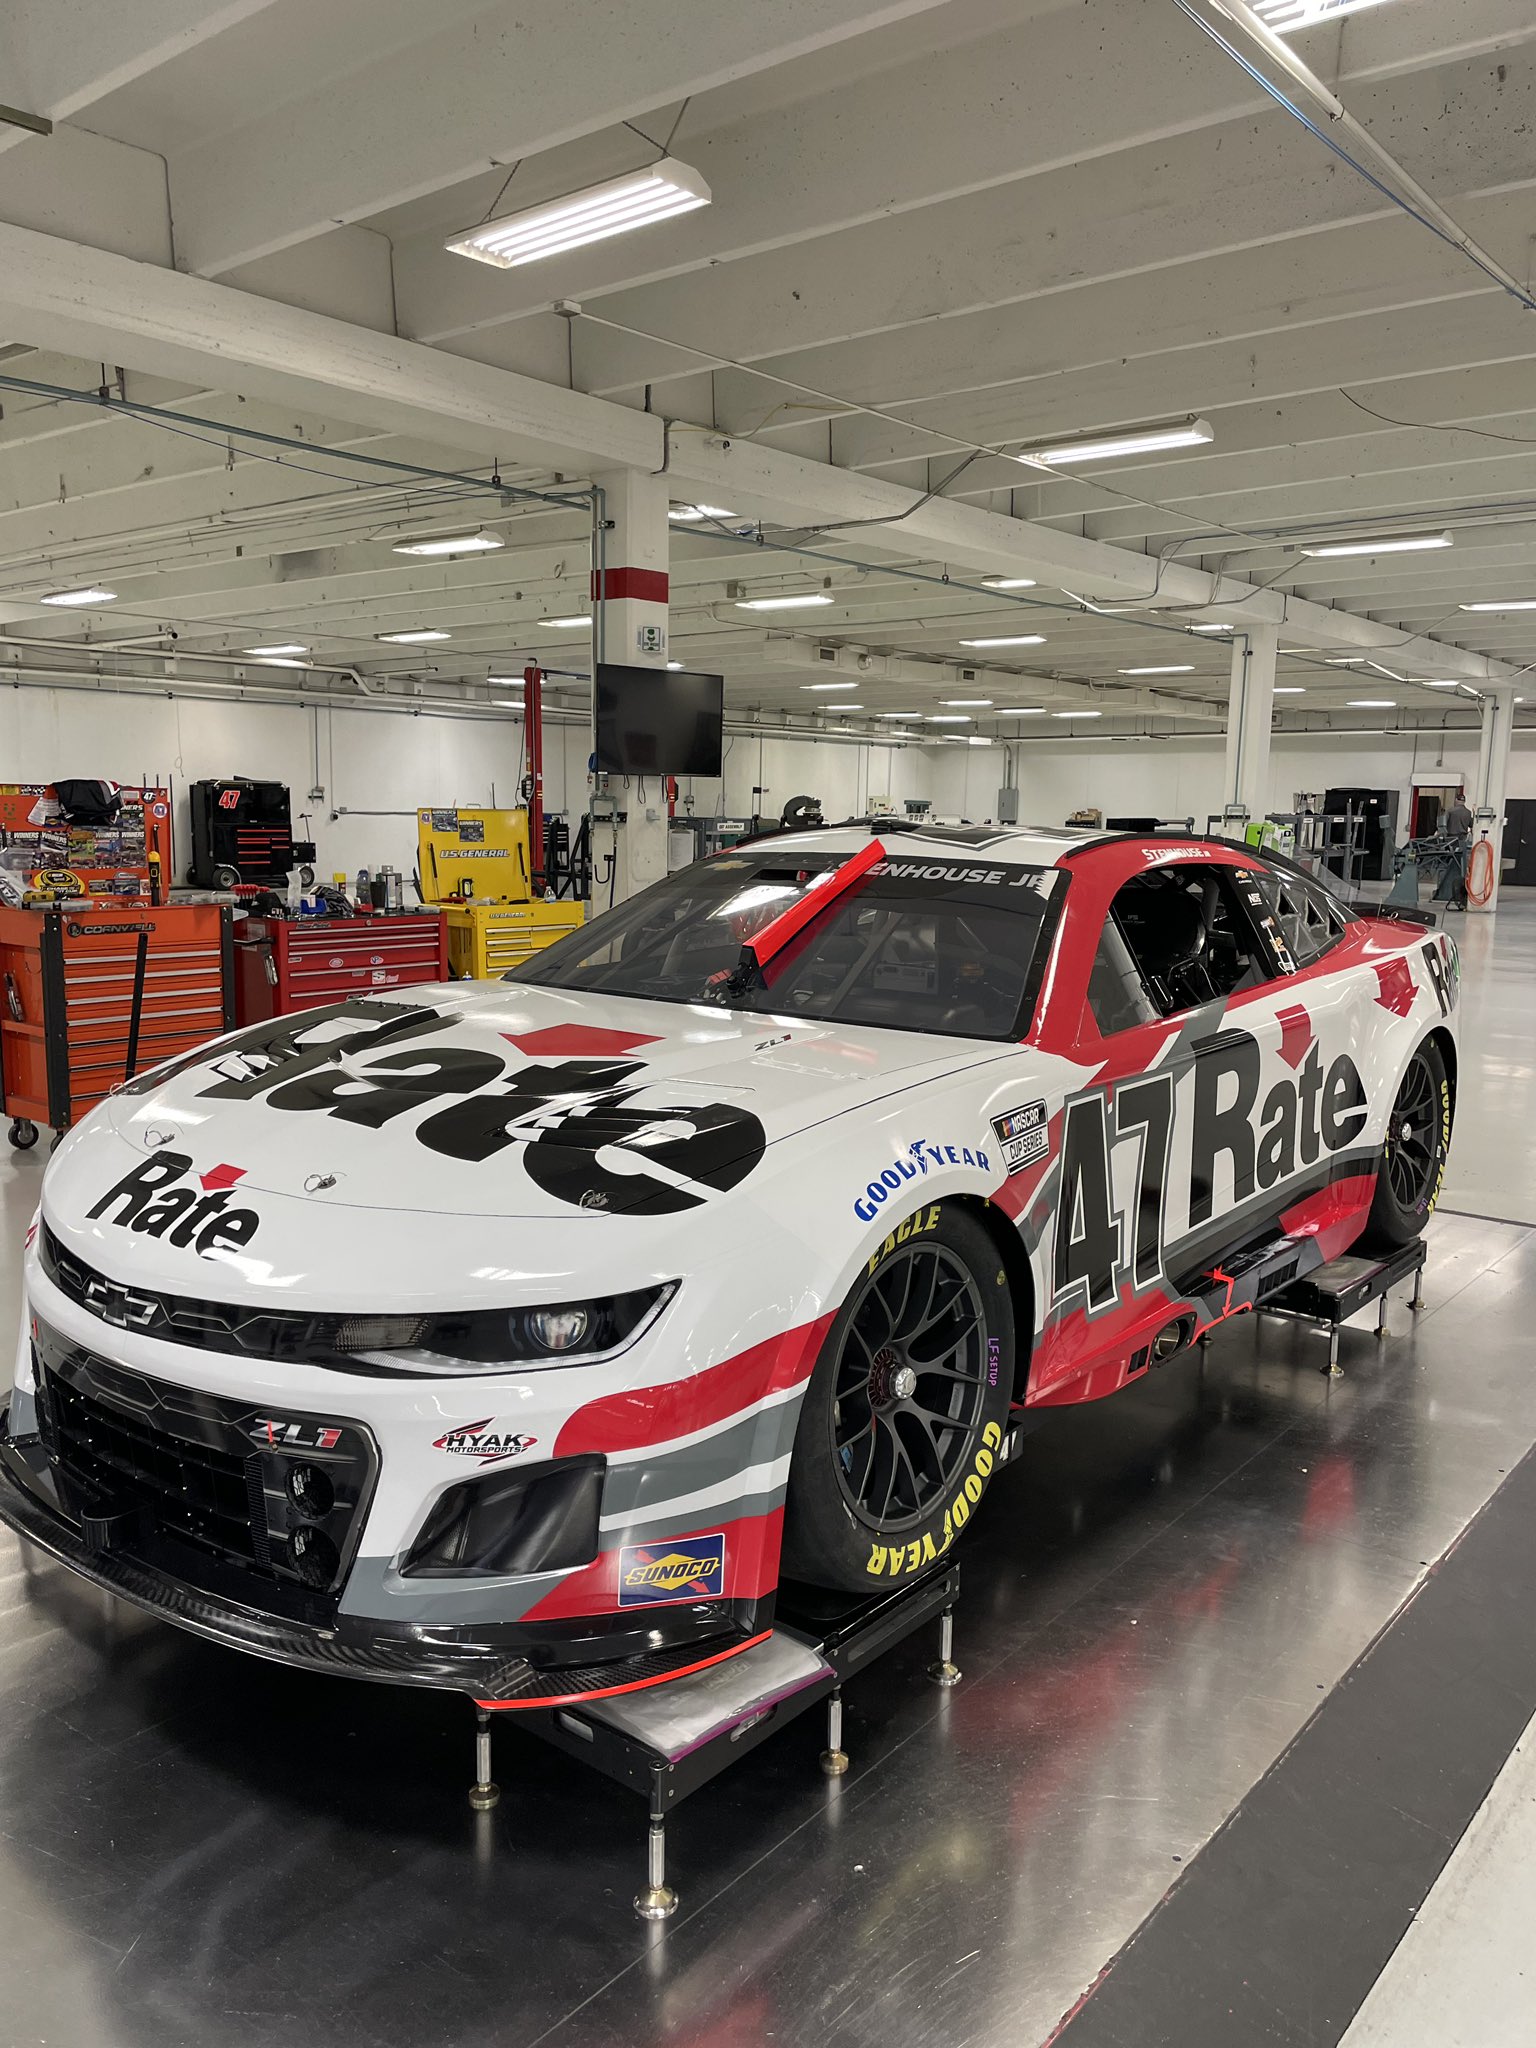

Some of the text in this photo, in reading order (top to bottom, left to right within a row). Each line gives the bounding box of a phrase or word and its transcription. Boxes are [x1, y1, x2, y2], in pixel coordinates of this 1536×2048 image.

[143, 792, 154, 801] 47
[219, 790, 240, 809] 47
[41, 831, 68, 844] WINNERS
[460, 849, 510, 858] GENERAL
[753, 1033, 792, 1052] ZL1
[1011, 1108, 1040, 1134] NASCAR
[1188, 1028, 1368, 1229] Rate
[1009, 1131, 1043, 1160] CUP SERIES
[85, 1149, 260, 1260] Rate
[1053, 1071, 1175, 1314] 47
[867, 1205, 942, 1278] EAGLE
[988, 1337, 1000, 1386] LF SETUP
[249, 1417, 343, 1449] ZL1
[446, 1433, 526, 1447] HYAK
[627, 1558, 718, 1584] SUNOCO
